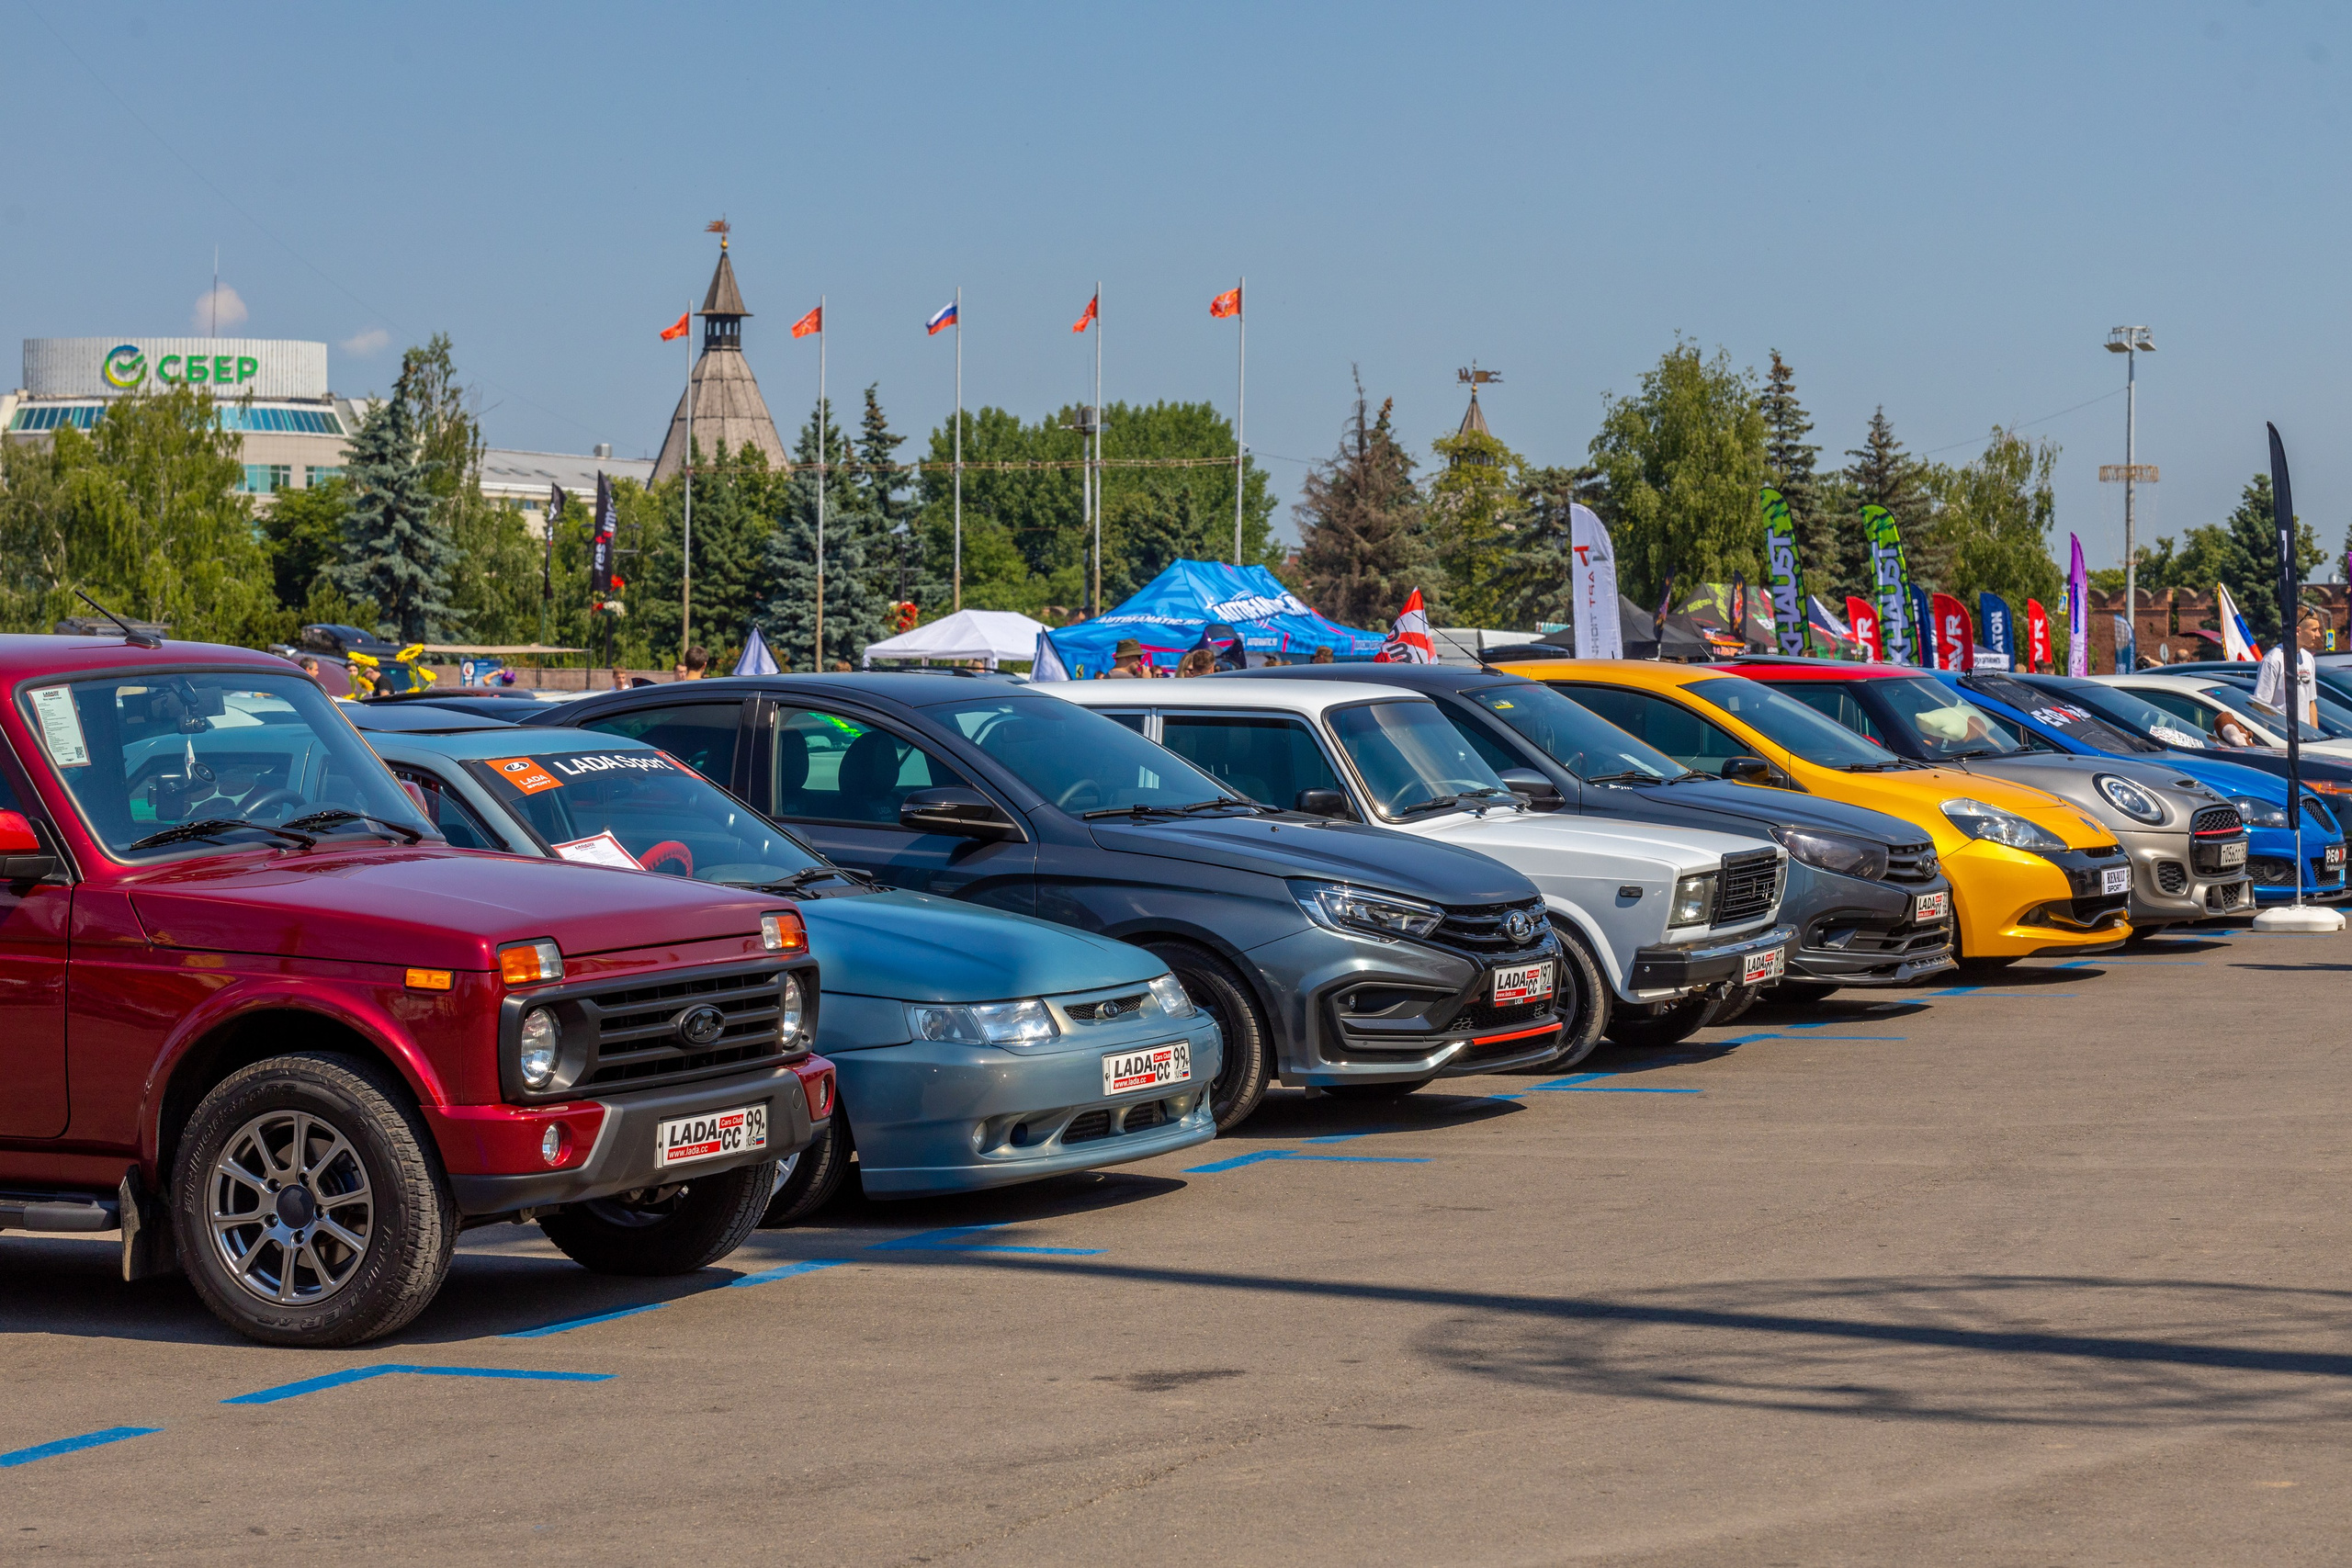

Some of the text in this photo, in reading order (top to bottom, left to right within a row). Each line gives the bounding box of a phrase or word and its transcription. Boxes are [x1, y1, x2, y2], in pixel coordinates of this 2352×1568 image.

[158, 355, 258, 384] СБЕР
[553, 754, 674, 776] LADA Sport
[519, 774, 549, 786] LADA
[526, 779, 551, 789] SPORT
[2107, 870, 2125, 884] RENAULT
[2108, 884, 2121, 893] SPORT
[1173, 1046, 1186, 1069] 99
[1157, 1061, 1170, 1081] CC
[1114, 1077, 1147, 1089] www.lada.cc
[721, 1115, 743, 1127] Cars Club
[746, 1109, 762, 1136] 99
[722, 1126, 741, 1150] CC
[669, 1145, 709, 1157] www.lada.cc
